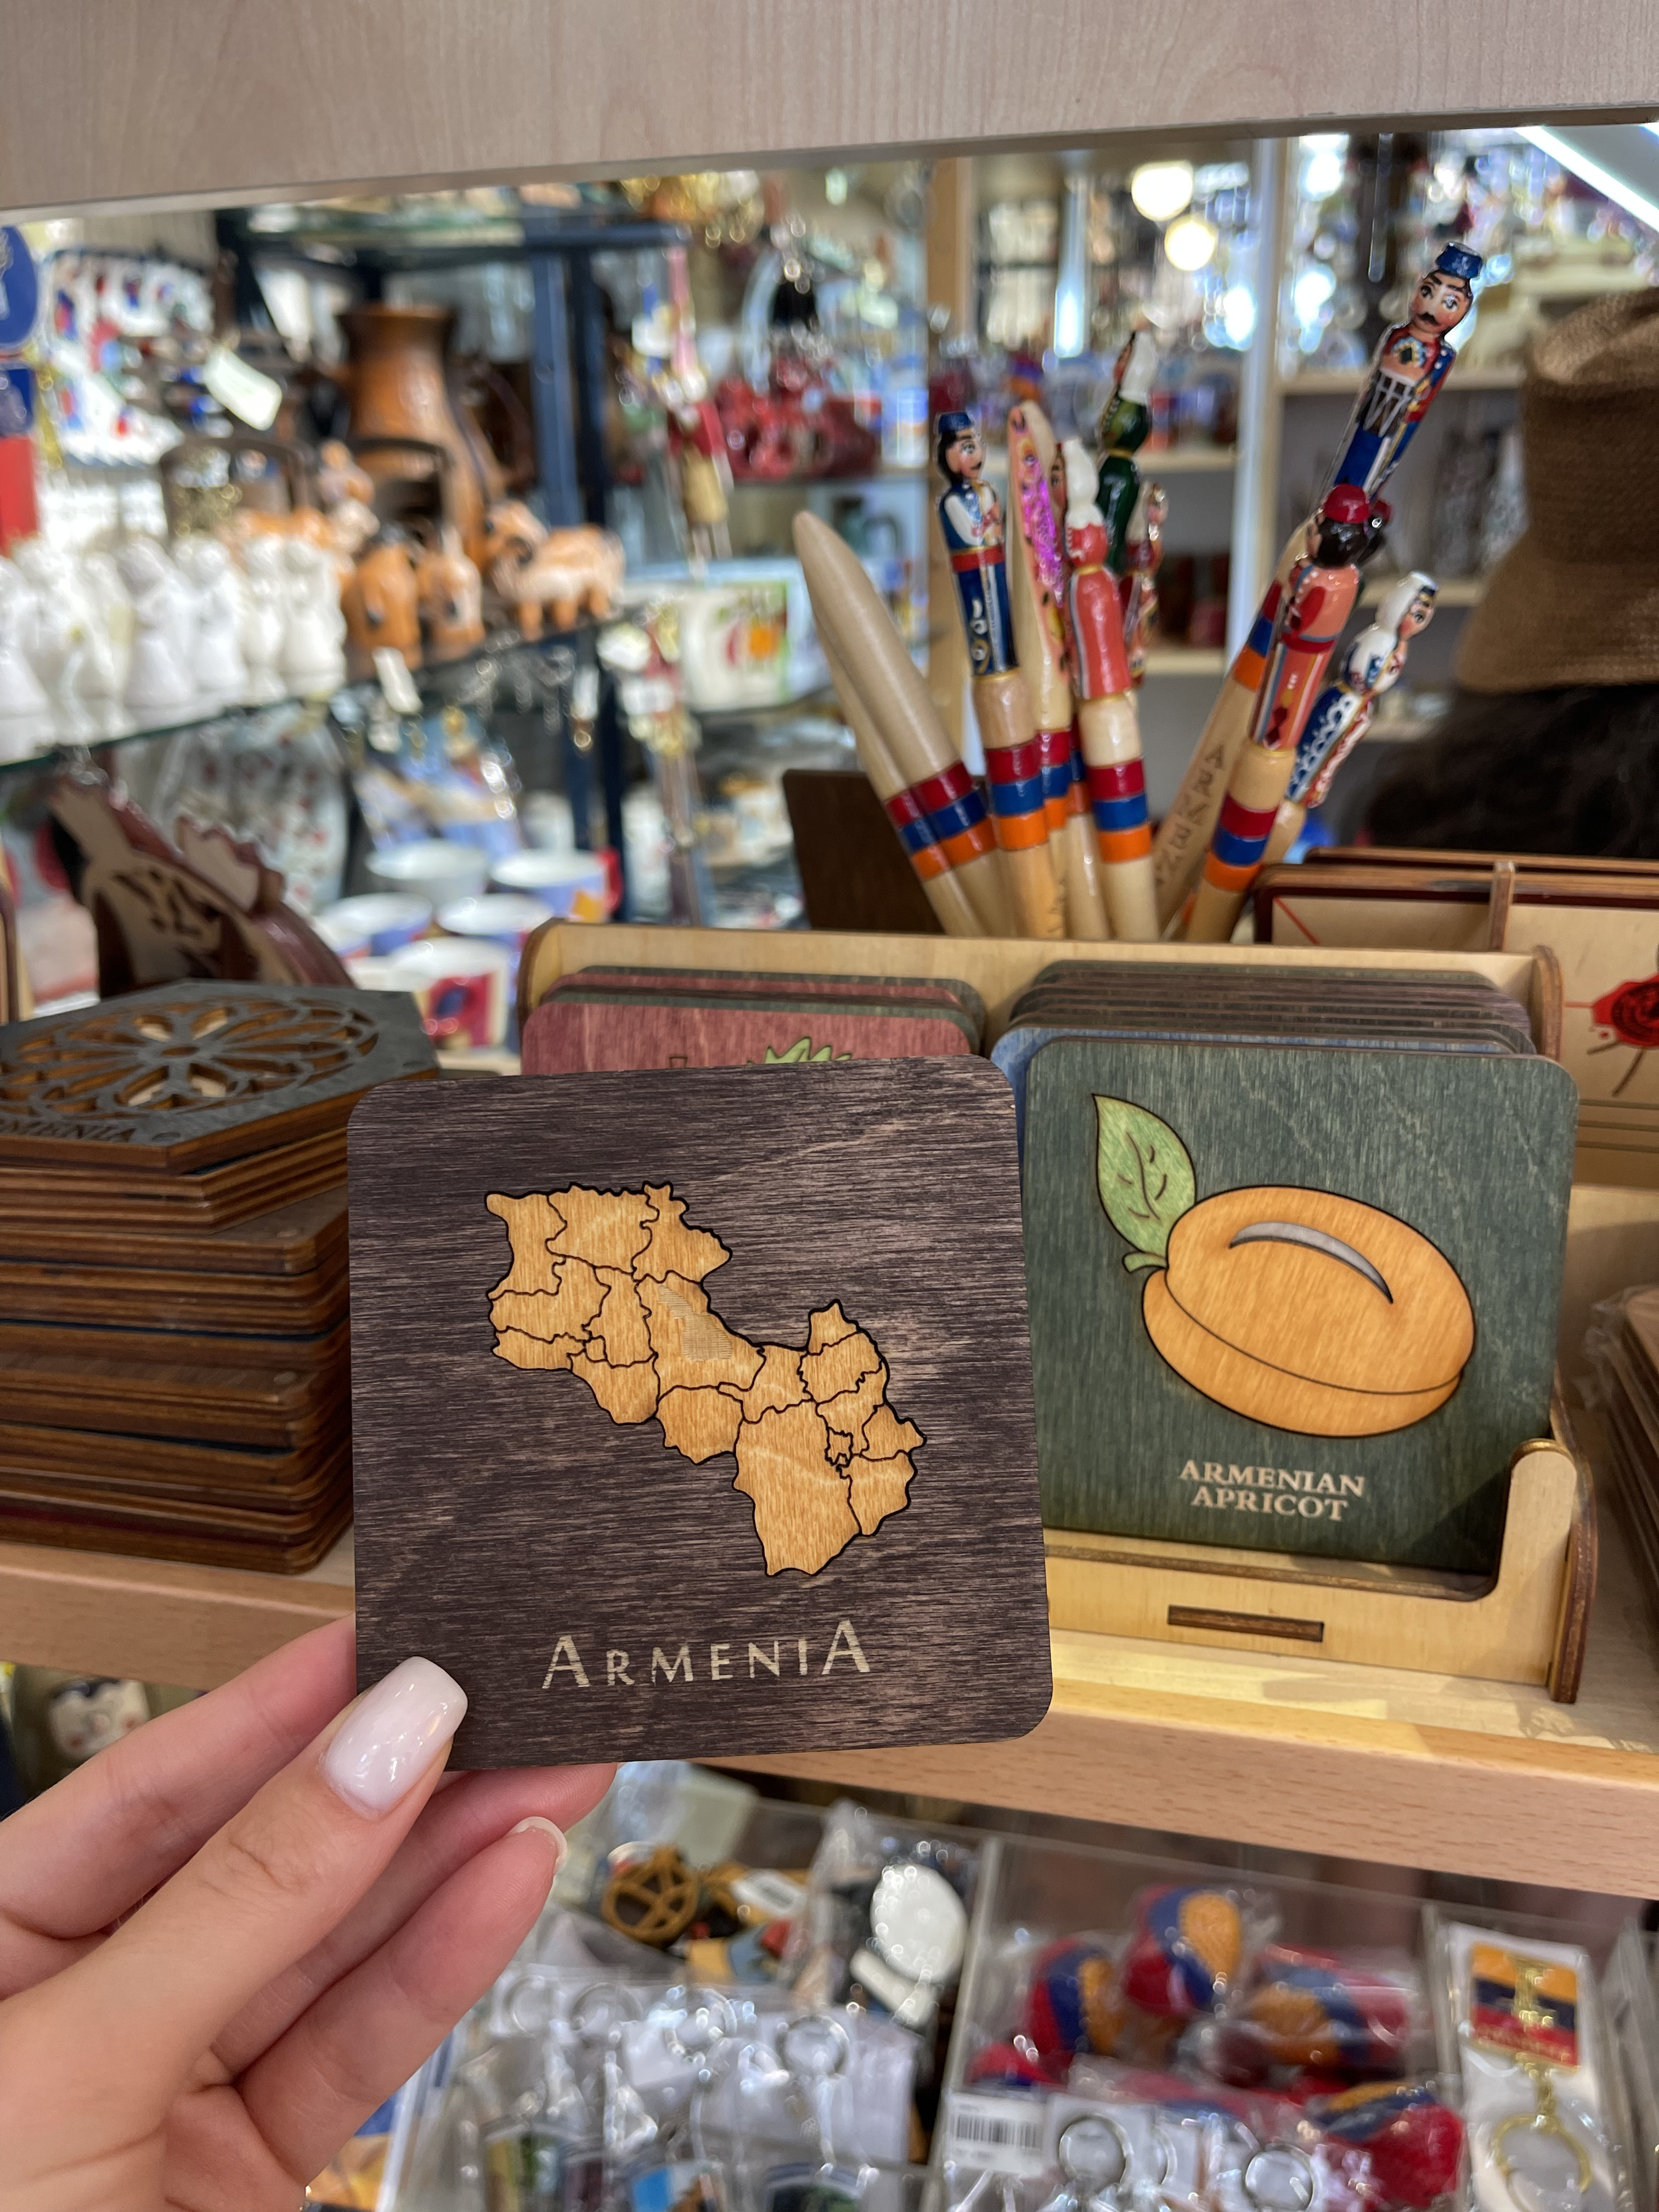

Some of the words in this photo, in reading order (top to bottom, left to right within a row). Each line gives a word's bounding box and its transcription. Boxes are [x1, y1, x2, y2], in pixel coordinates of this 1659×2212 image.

[1178, 1459, 1366, 1498] ARMENIAN
[1190, 1485, 1350, 1521] APRICOT
[541, 1619, 871, 1689] ARMENIA
